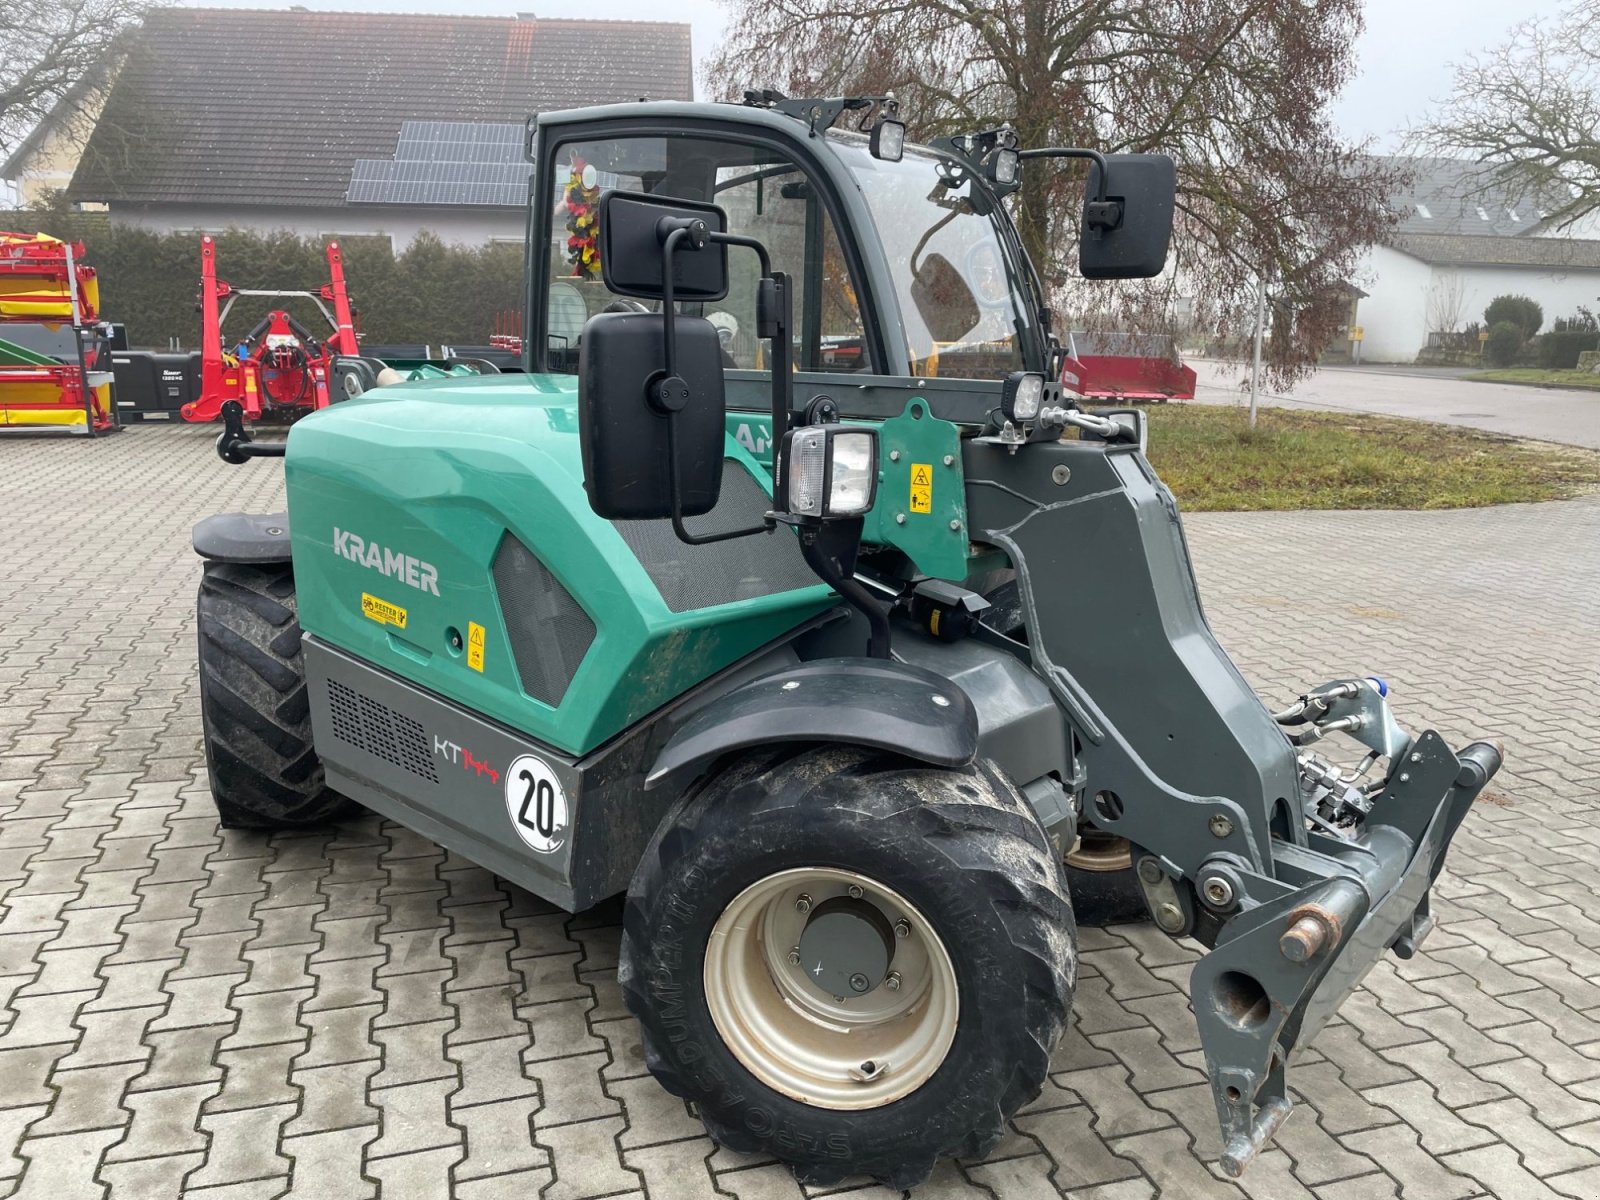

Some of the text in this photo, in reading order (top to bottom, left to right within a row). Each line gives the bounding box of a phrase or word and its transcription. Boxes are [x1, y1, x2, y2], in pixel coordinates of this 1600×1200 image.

[333, 526, 441, 598] KRAMER
[374, 601, 397, 617] RESTER
[518, 769, 555, 839] 20
